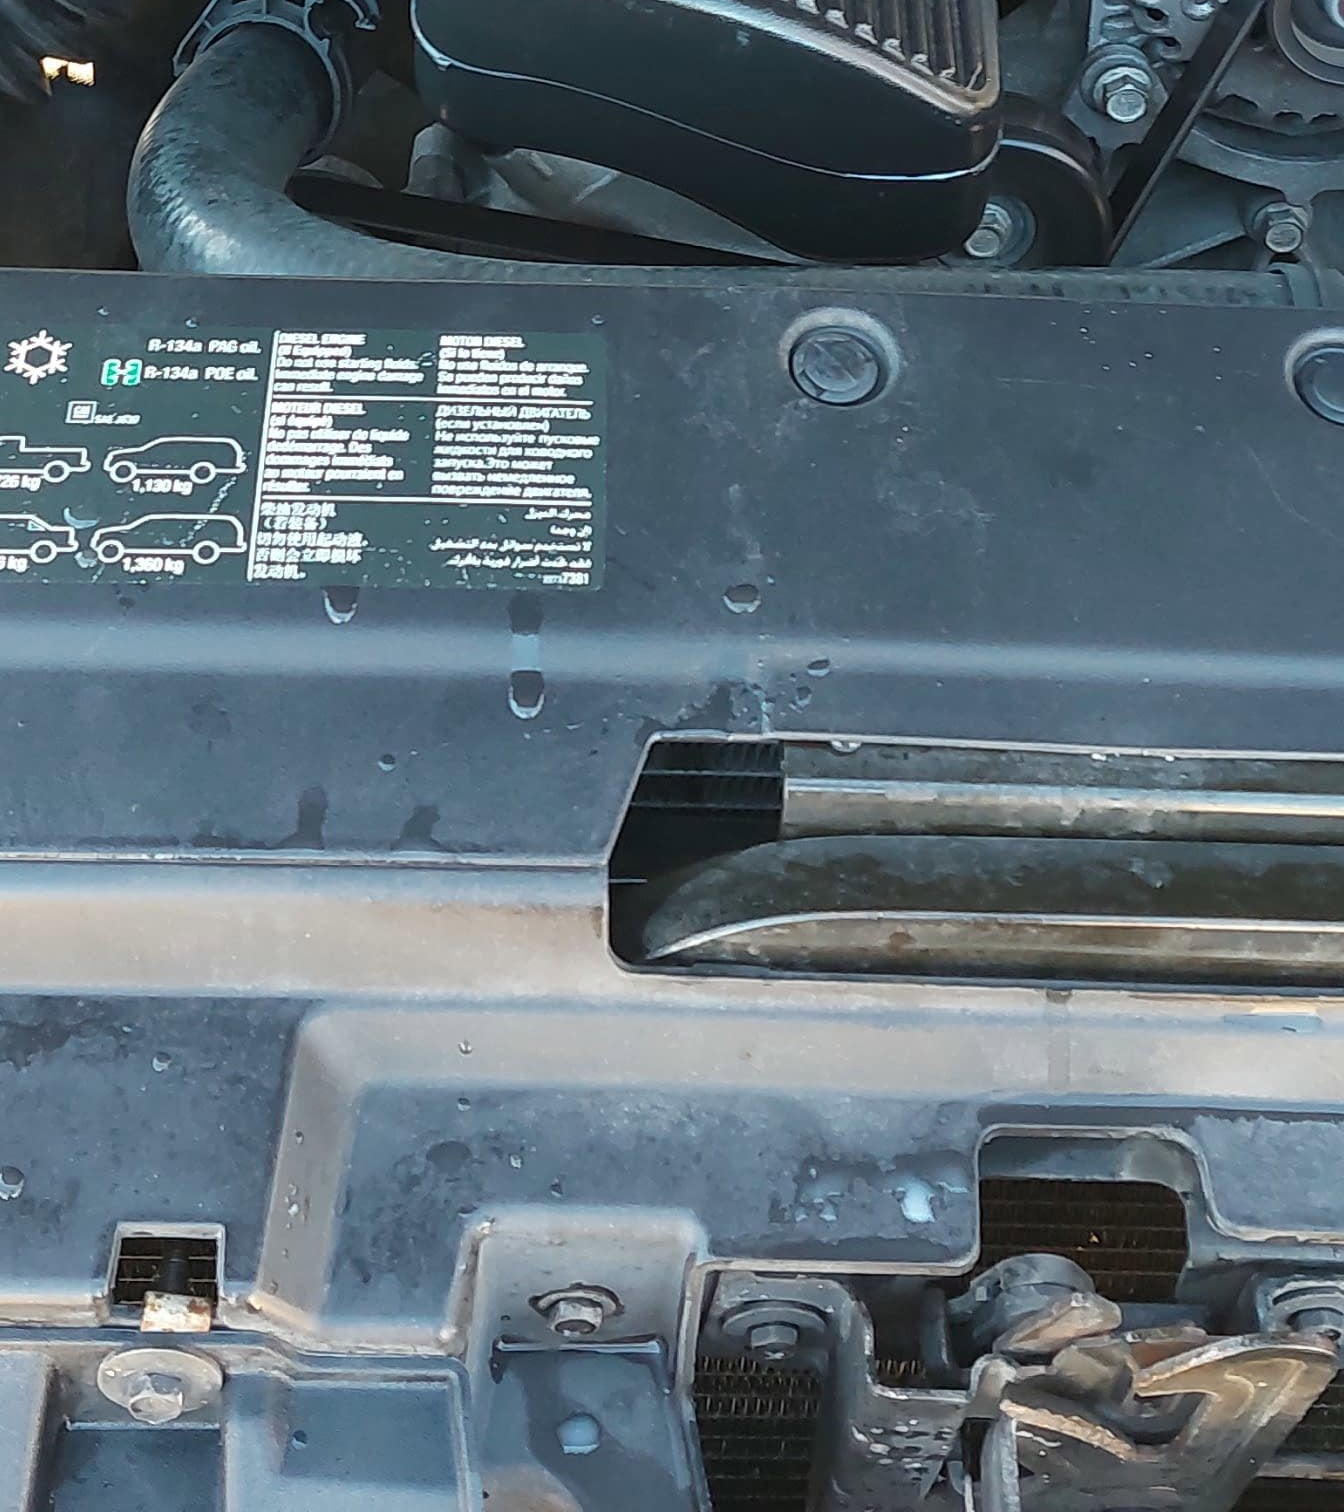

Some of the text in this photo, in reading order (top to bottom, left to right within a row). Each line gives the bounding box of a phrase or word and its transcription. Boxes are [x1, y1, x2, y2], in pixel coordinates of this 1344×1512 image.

[148, 339, 203, 352] R-134a
[208, 340, 238, 353] PAG
[144, 366, 198, 380] R-134a
[205, 367, 235, 380] POE
[20, 475, 42, 491] kg
[172, 479, 193, 495] kg
[7, 556, 28, 572] kg
[164, 558, 185, 575] kg
